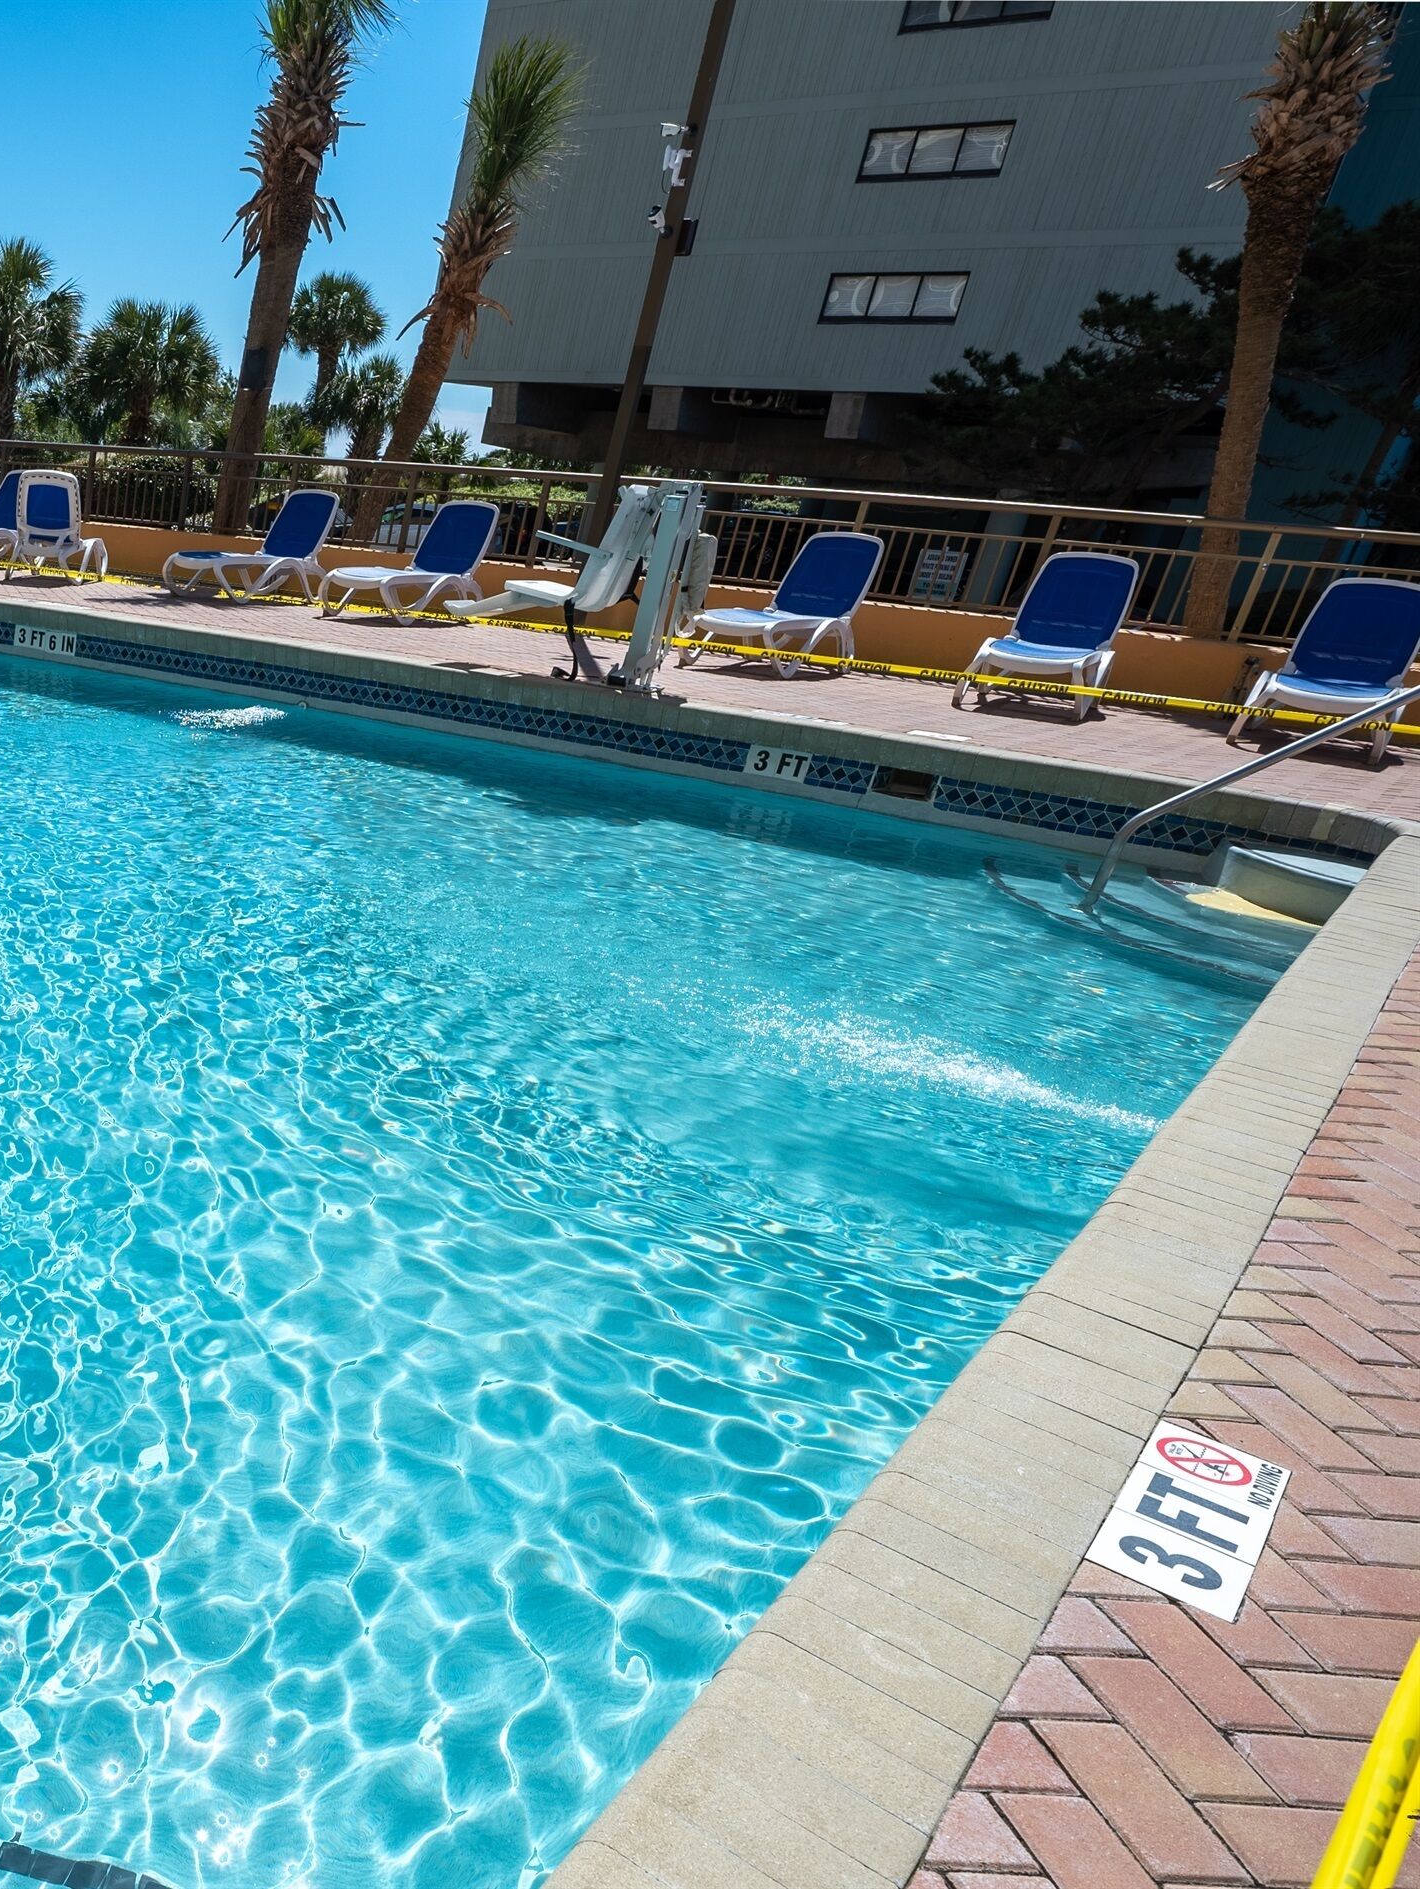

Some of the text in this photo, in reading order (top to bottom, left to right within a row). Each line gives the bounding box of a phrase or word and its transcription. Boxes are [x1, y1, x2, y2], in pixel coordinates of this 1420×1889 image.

[18, 628, 74, 653] 3 FT 6 IN
[487, 620, 529, 630] CAUTION
[553, 627, 596, 636] CATION
[688, 642, 736, 655] CAUTION
[760, 651, 811, 664] CAUTION
[838, 660, 892, 674] CAUTION
[920, 670, 977, 684] CAUTION
[1008, 680, 1069, 695] CAUTION
[1102, 690, 1168, 706] CAUTION
[1204, 703, 1276, 719] CAUTION
[754, 750, 808, 778] 3 FT
[1246, 1463, 1284, 1510] NO DIVING
[1118, 1472, 1250, 1590] 3 FT
